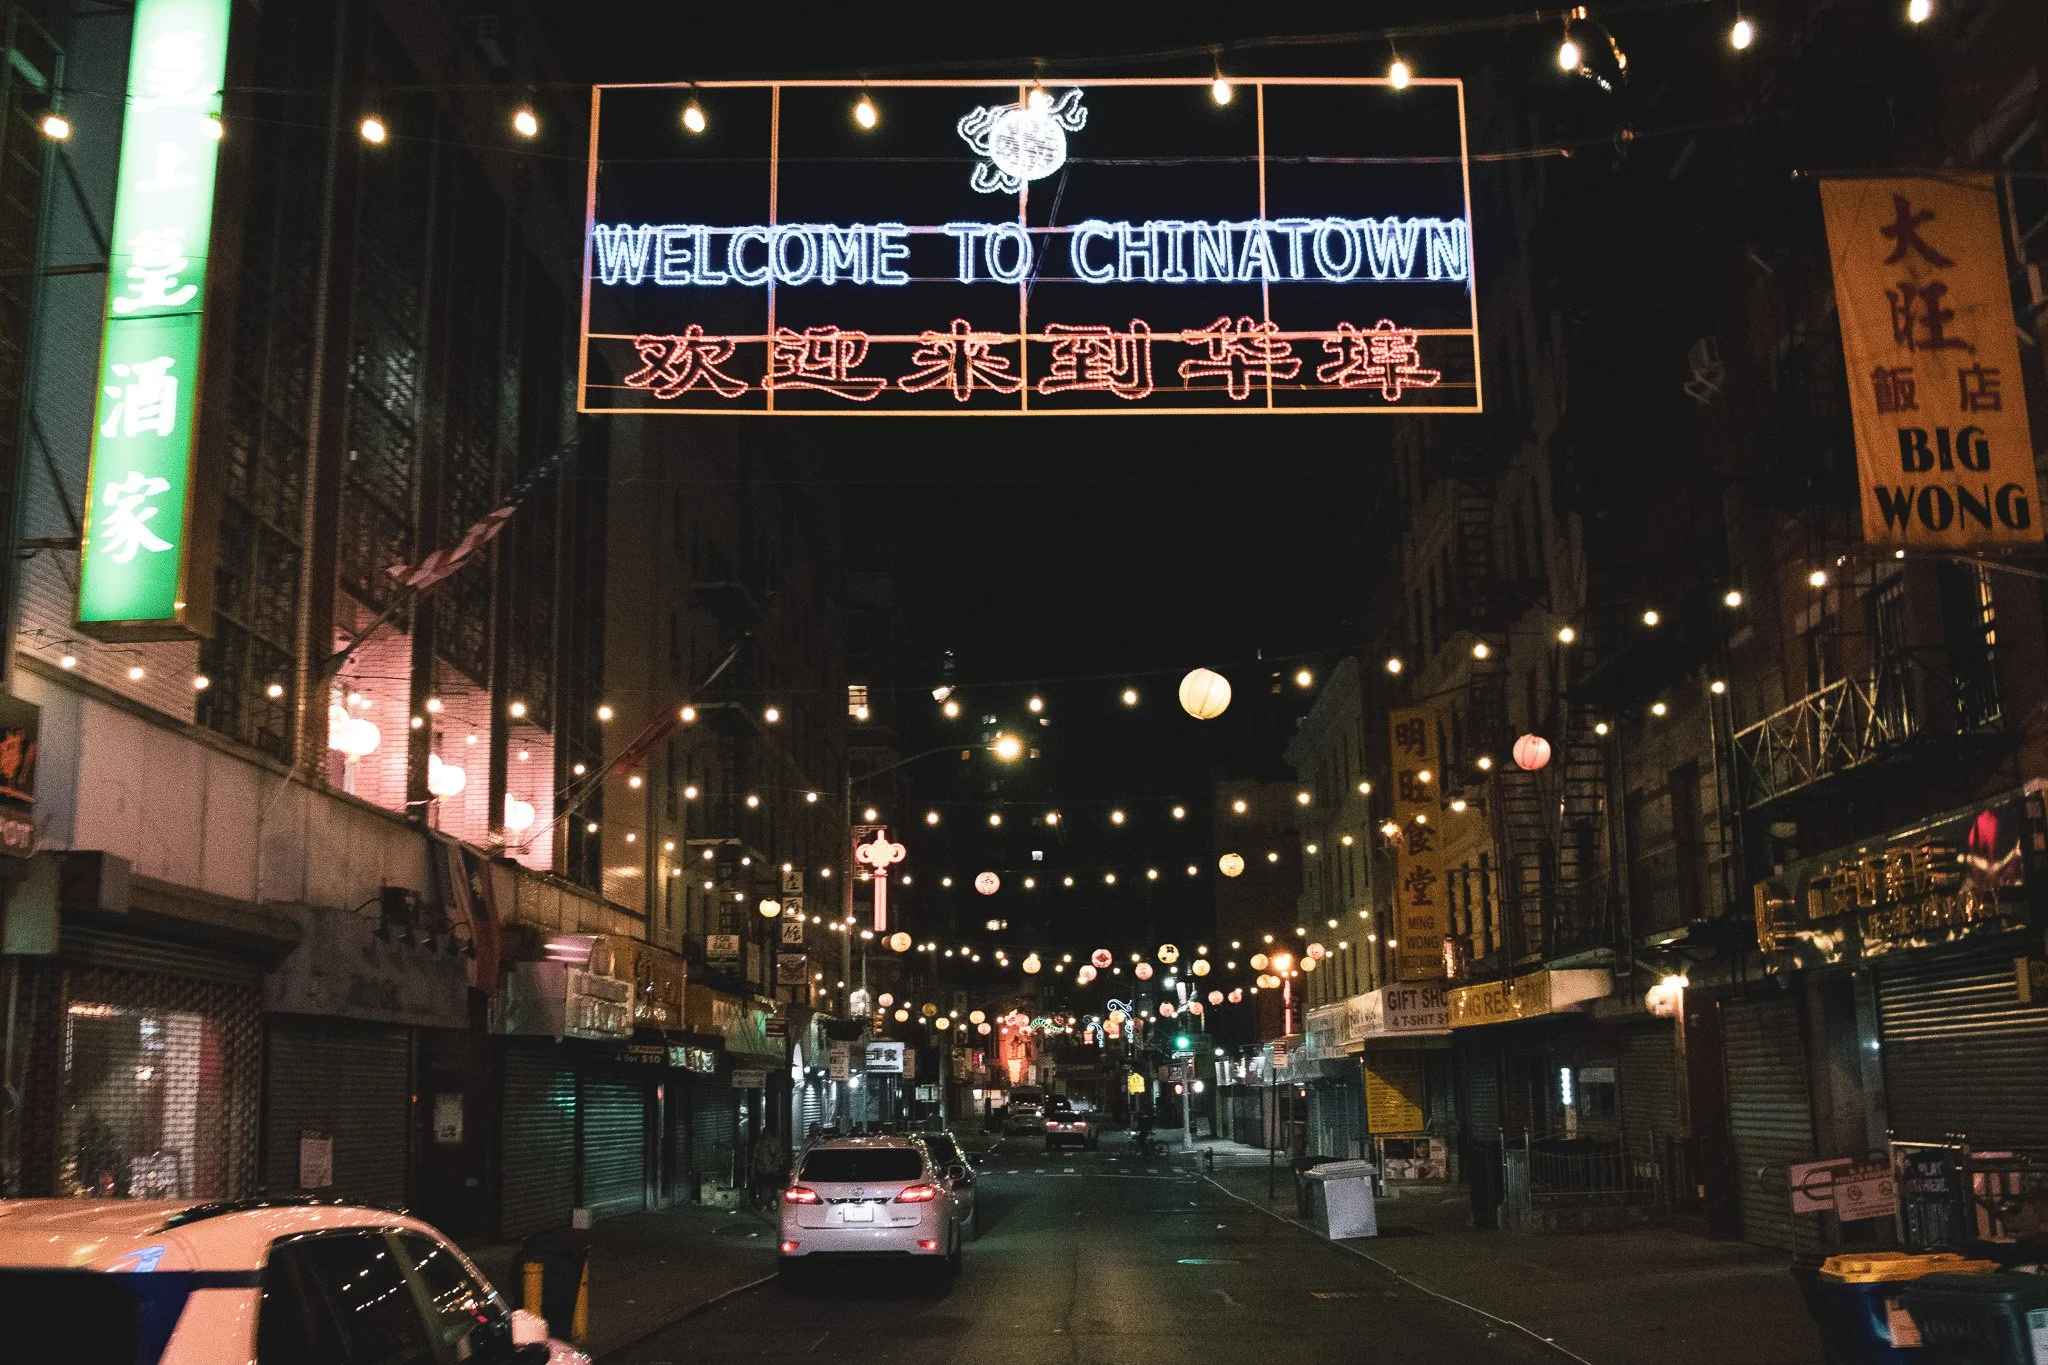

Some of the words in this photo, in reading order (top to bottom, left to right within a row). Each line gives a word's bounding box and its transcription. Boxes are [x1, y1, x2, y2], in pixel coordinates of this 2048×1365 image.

[594, 223, 910, 287] WELCOME
[940, 221, 1033, 286] TO
[1071, 217, 1470, 284] CHINATOWN
[1880, 190, 1977, 354] 大旺
[1869, 362, 2003, 415] 飯店
[1897, 425, 1991, 473] BIG
[1874, 482, 2031, 533] WONG
[1387, 990, 1417, 1012] GIFT
